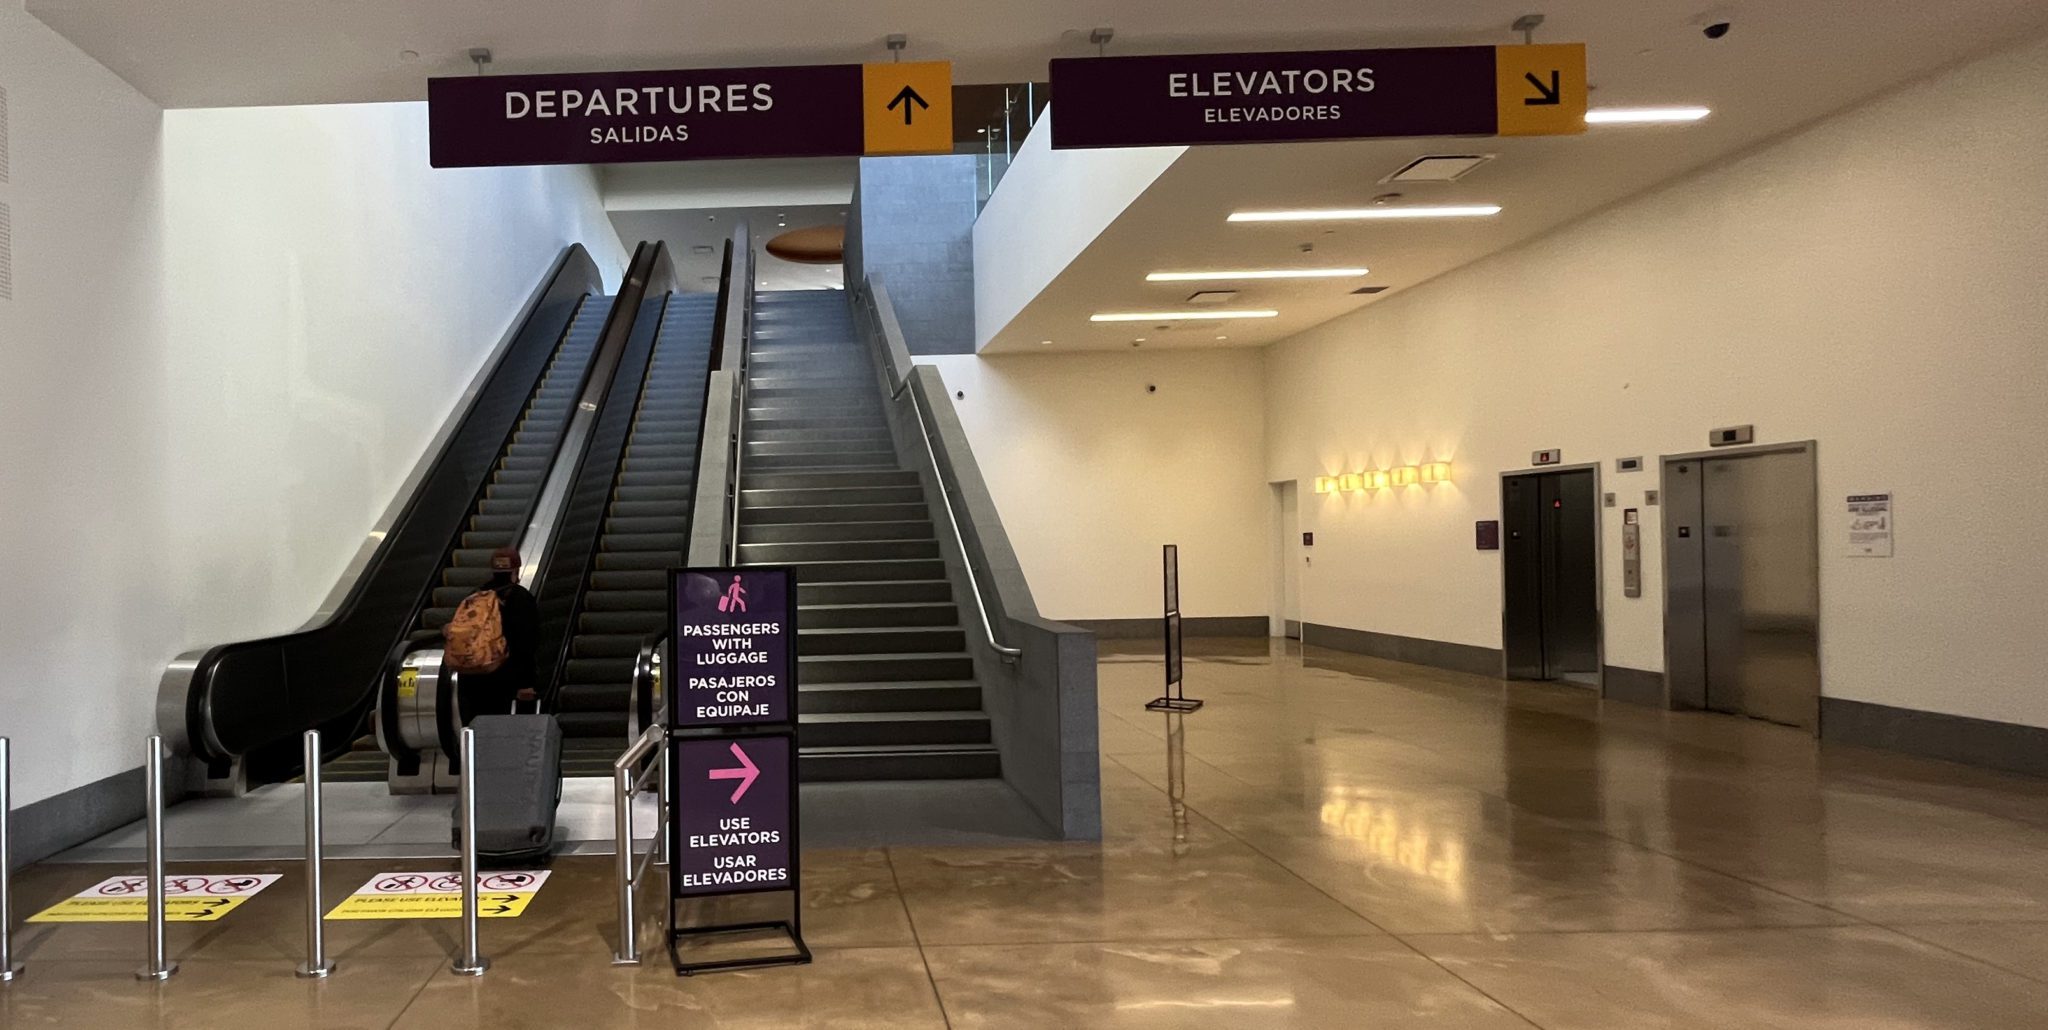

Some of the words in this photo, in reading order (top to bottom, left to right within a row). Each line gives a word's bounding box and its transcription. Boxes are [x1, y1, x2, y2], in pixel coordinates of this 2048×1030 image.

[1169, 67, 1376, 98] ELEVATORS
[505, 83, 774, 119] DEPARTURES
[1204, 105, 1342, 123] ELEVADORES
[590, 124, 689, 144] SALIDAS
[683, 622, 780, 637] PASSENGERS
[712, 637, 752, 650] WITH
[696, 651, 768, 665] LUGGAGE
[689, 675, 776, 689] PASAJEROS
[716, 691, 749, 702] CON
[696, 704, 770, 718] EQUIPAJE
[719, 817, 750, 831] USE
[689, 831, 780, 848] ELEVATORS
[713, 855, 757, 869] USAR
[683, 868, 787, 887] ELEVADORES
